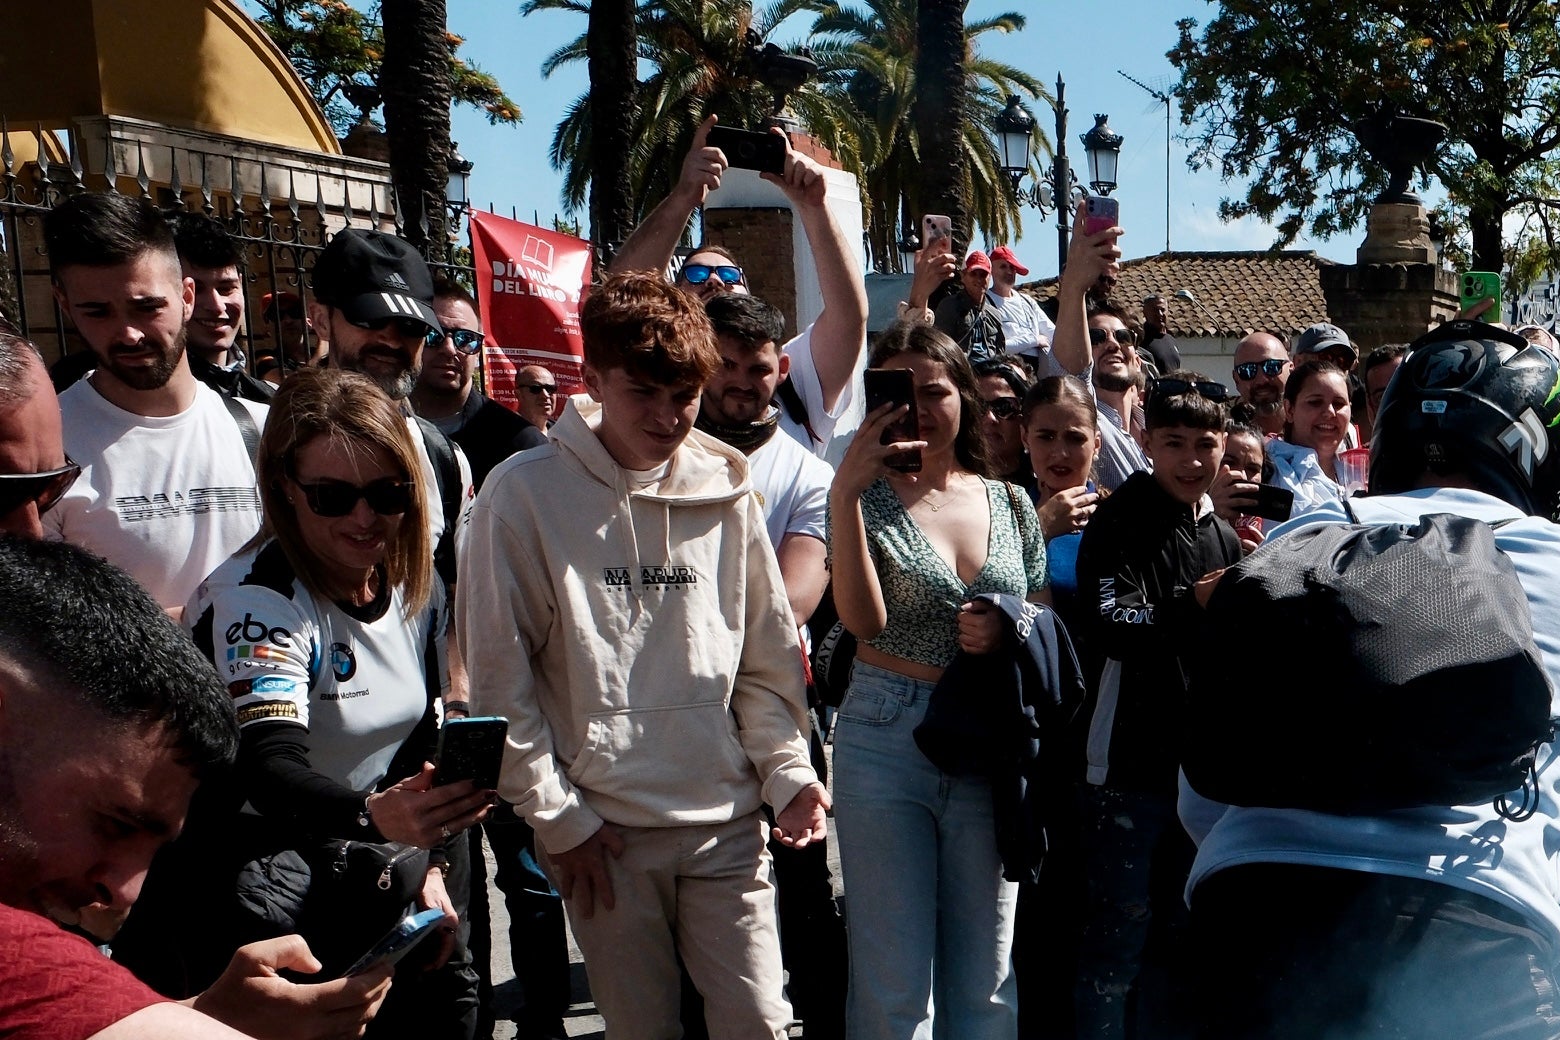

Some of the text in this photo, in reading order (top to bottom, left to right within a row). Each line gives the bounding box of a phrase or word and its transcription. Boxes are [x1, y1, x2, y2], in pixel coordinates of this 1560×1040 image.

[493, 258, 526, 279] DÍA
[493, 279, 525, 296] DEL
[606, 584, 698, 593] georaphic
[225, 613, 292, 649] ebc
[340, 688, 370, 700] Motorrad
